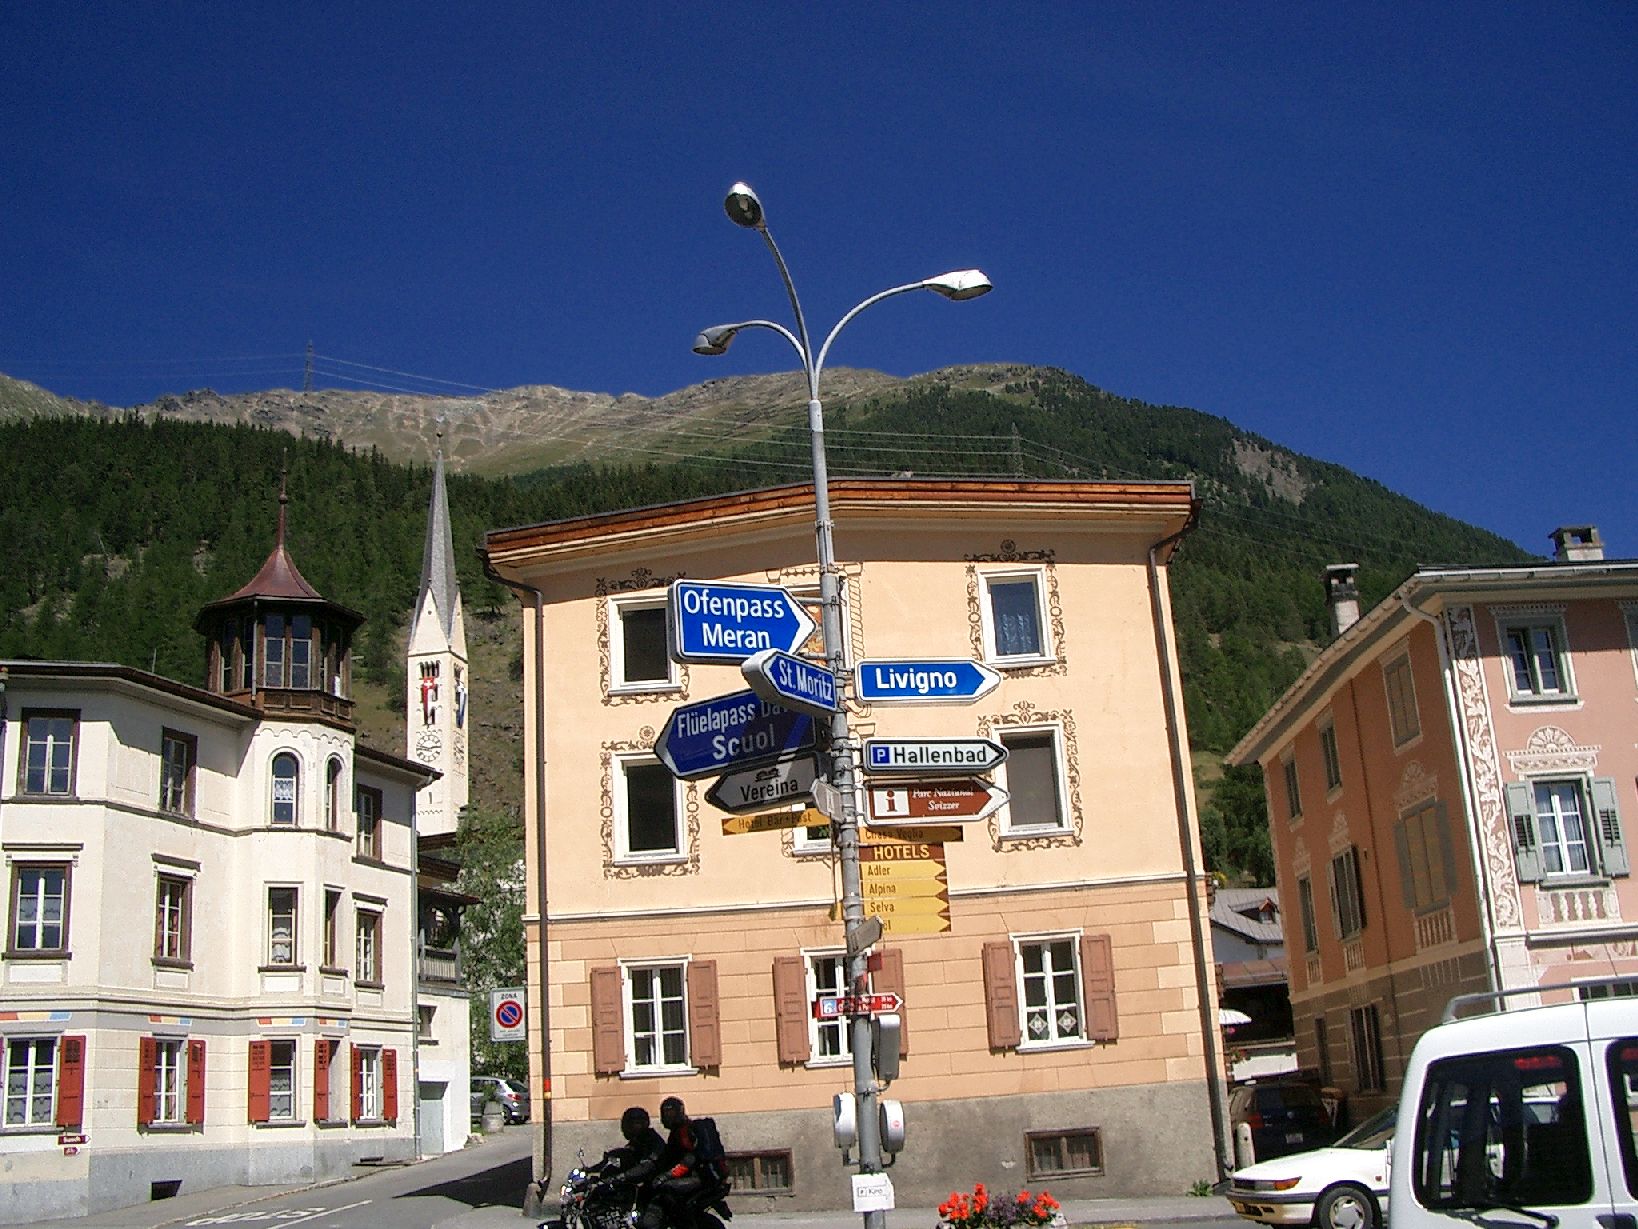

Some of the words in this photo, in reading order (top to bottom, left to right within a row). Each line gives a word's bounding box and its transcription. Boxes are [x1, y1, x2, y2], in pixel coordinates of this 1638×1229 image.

[683, 589, 785, 623] Ofenpass
[702, 623, 771, 649] Meran
[875, 667, 958, 694] Livigno
[677, 703, 756, 738] Flüelapass
[712, 723, 775, 760] Scuol
[894, 746, 987, 764] Hallenbad
[740, 779, 798, 802] Vereina
[738, 816, 762, 829] Hotel
[874, 844, 930, 860] HOTELS
[867, 864, 891, 876] Adler
[869, 883, 896, 896] Alpina
[870, 902, 895, 913] Selva
